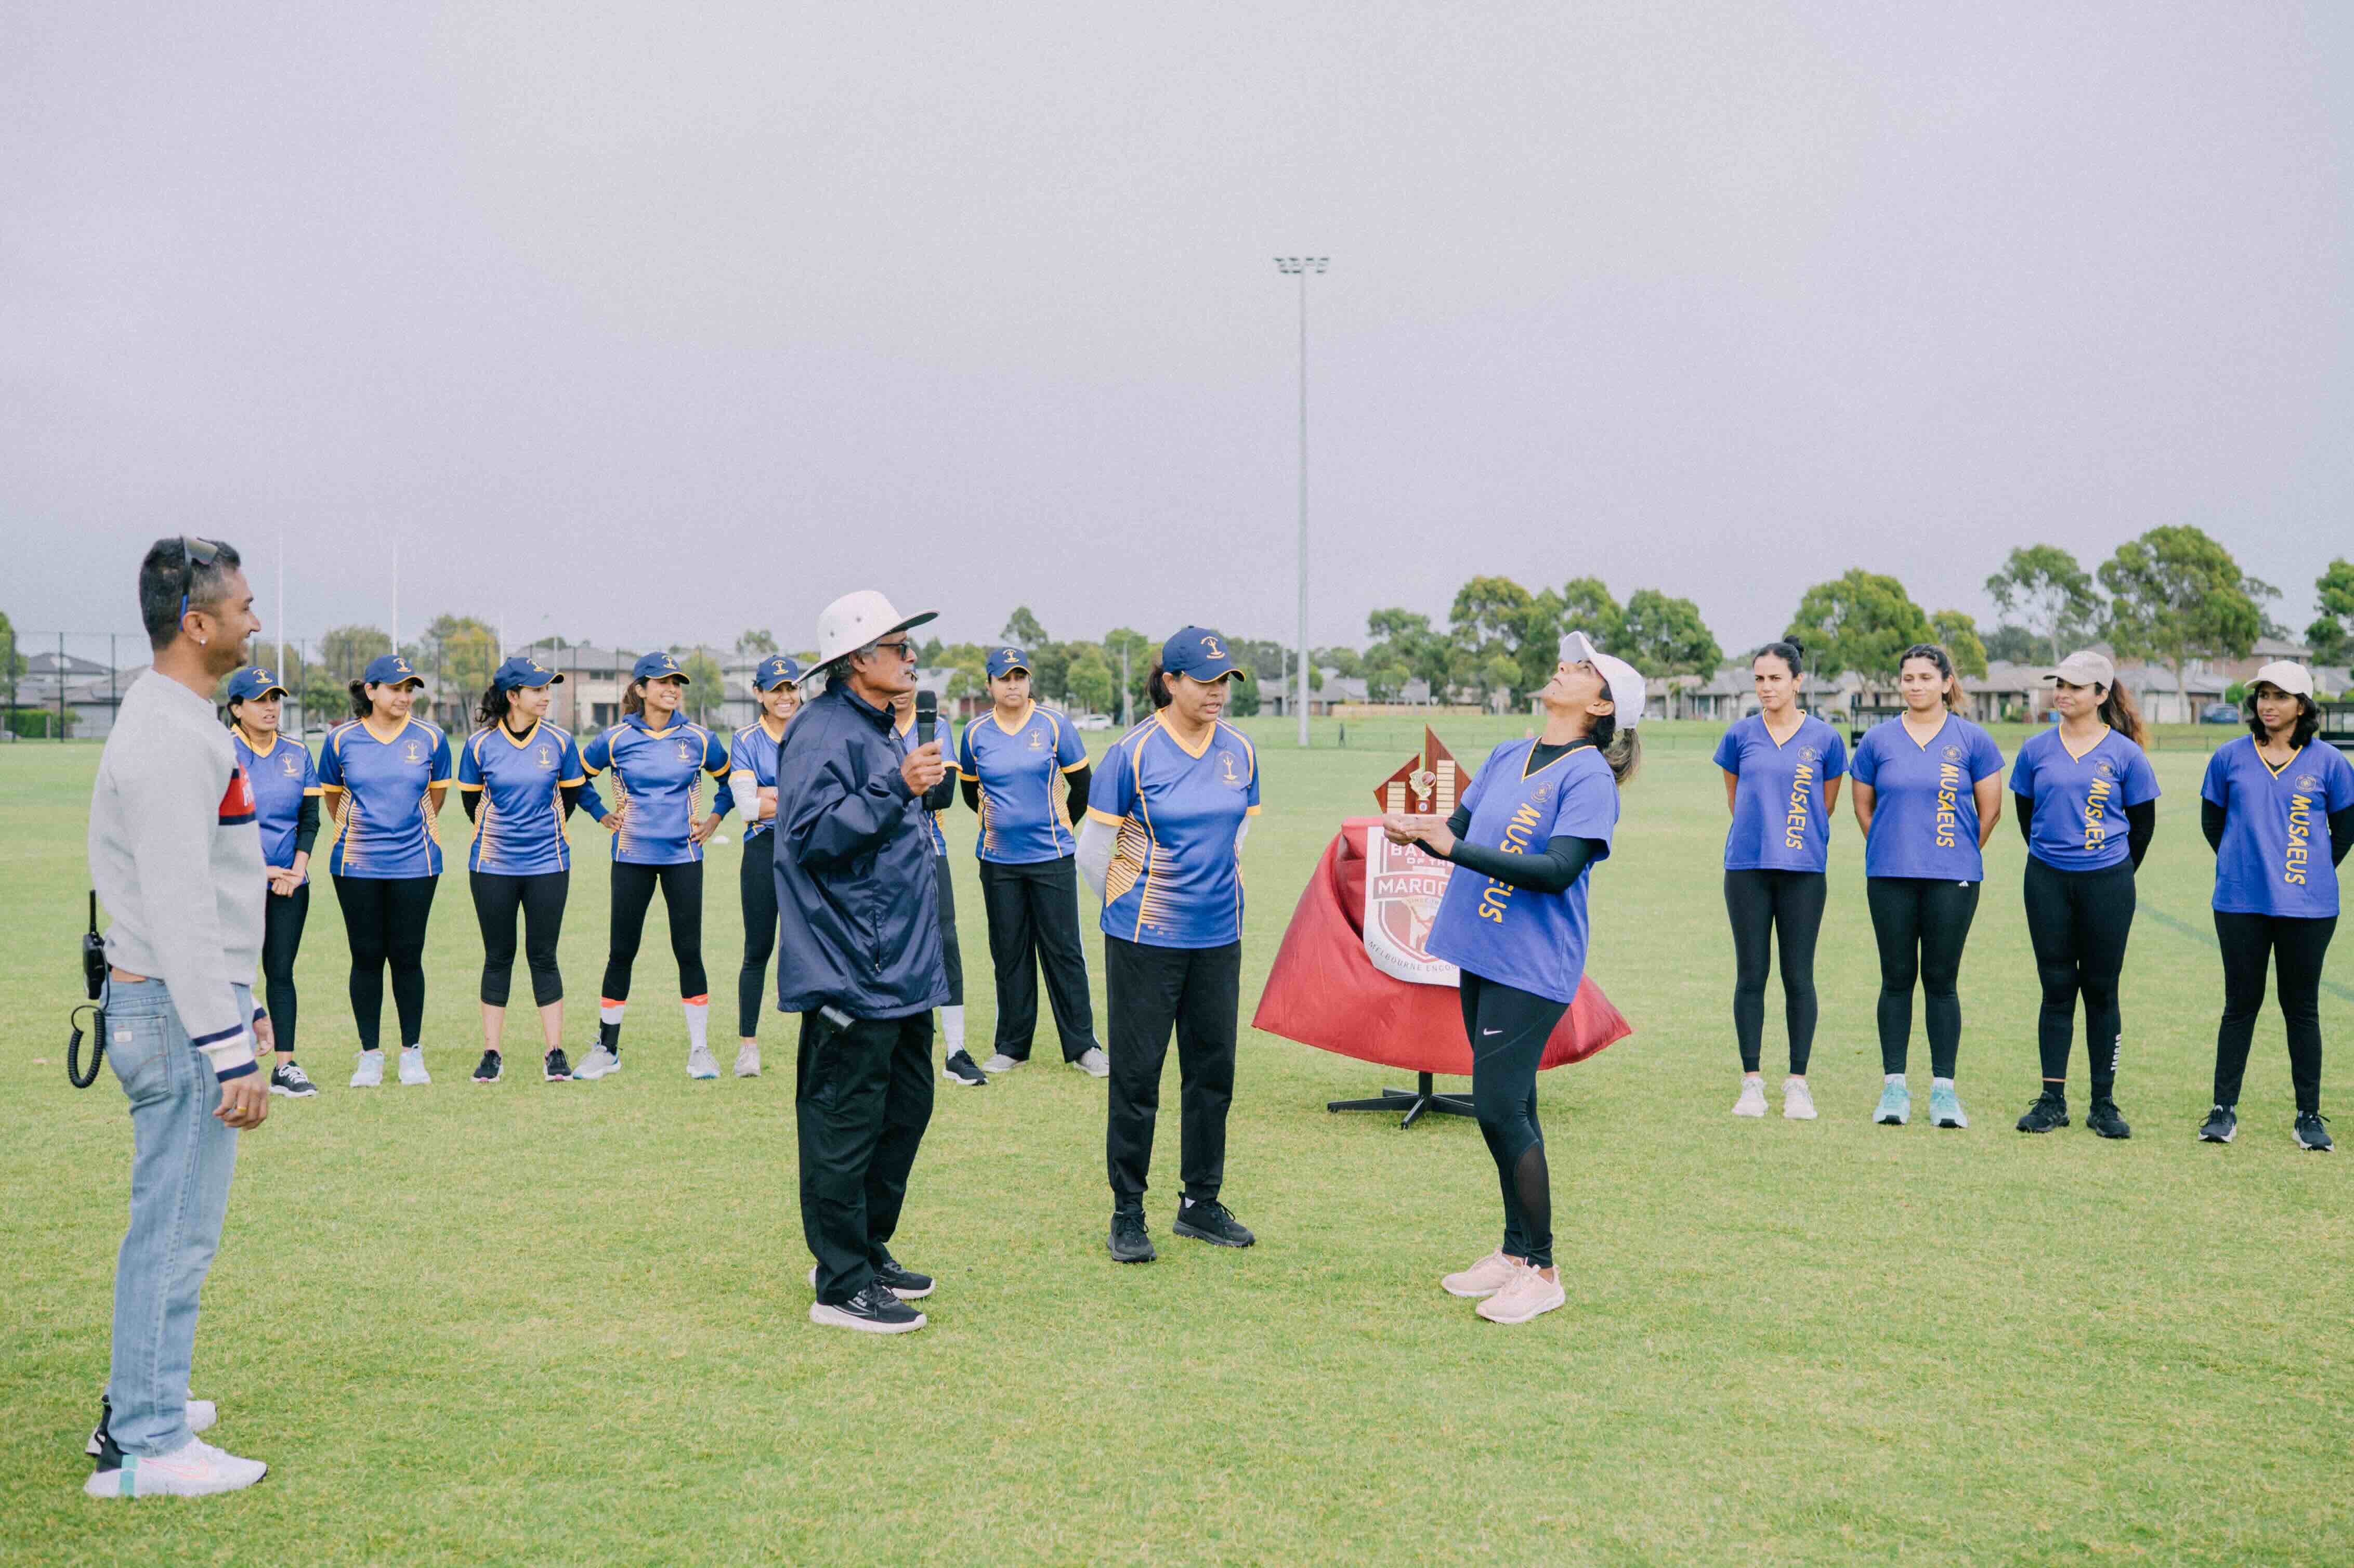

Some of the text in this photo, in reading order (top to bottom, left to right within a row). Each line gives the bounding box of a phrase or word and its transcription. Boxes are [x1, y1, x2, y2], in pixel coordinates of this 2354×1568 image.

[1785, 763, 1814, 850] MUSAEUS
[1936, 763, 1959, 848] MUSAEUS
[2285, 794, 2312, 885] MUSAEUS
[1478, 802, 1541, 923] MUSUS
[1368, 941, 1423, 971] MELBOURNE
